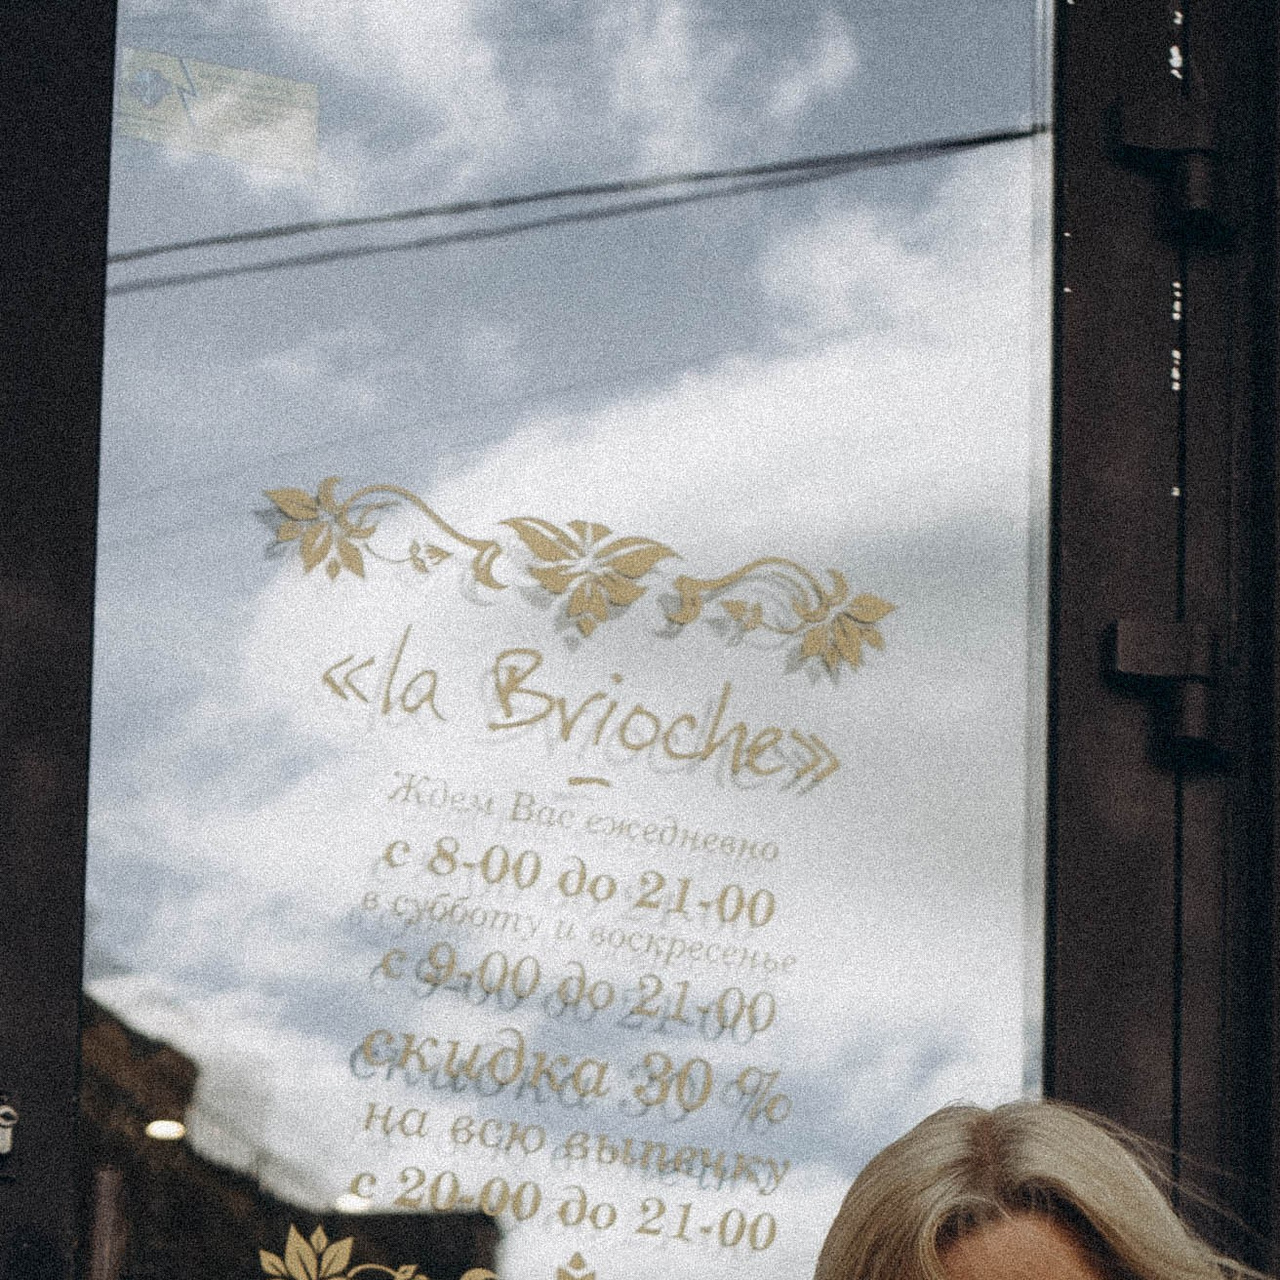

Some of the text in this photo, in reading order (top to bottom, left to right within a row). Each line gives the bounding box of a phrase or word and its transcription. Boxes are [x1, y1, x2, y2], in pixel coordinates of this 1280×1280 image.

[510, 791, 575, 830] Вас
[586, 815, 780, 864] ежедневно
[383, 835, 777, 929] с 8-00 до 21-00
[392, 889, 543, 940] субботу
[555, 917, 576, 940] и
[588, 921, 798, 976] воскресенье
[425, 940, 541, 999] 9-00
[558, 961, 615, 1010] до
[633, 974, 776, 1033] 21-00
[363, 1028, 793, 1125] скидка 30 %
[363, 1101, 791, 1195] на всю выпечку
[350, 1167, 778, 1251] с 20-00 до 21-00
